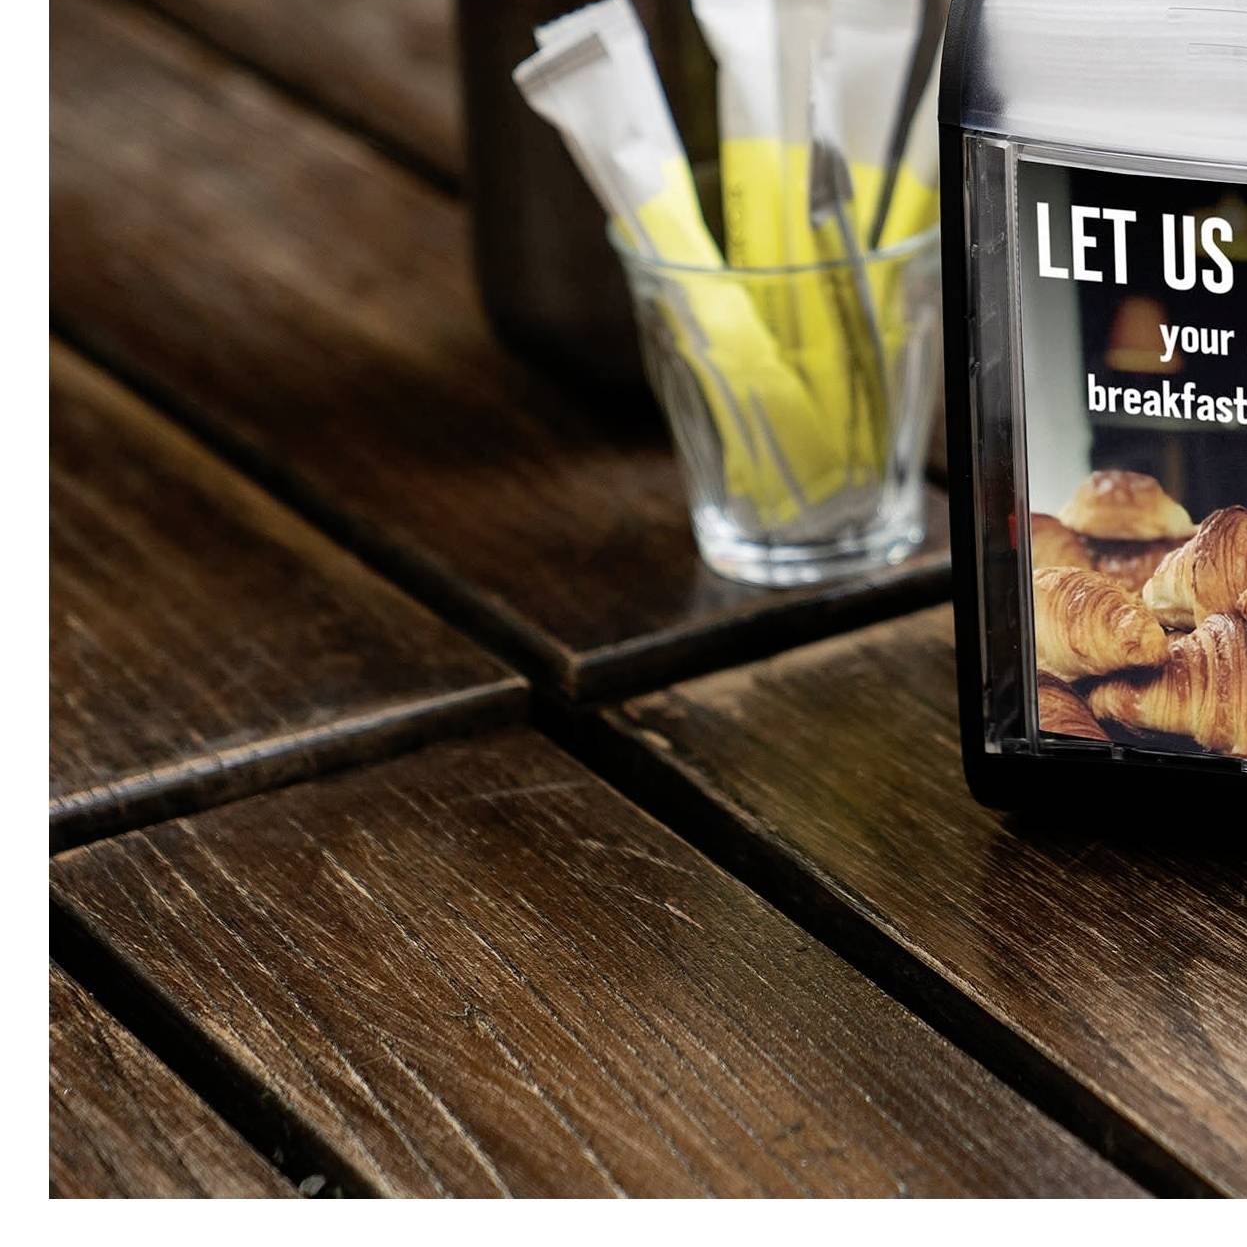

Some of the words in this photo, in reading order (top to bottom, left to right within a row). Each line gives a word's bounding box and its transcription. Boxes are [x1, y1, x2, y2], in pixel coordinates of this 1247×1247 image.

[1036, 201, 1137, 285] LET
[1162, 213, 1234, 294] US
[1159, 323, 1236, 363] your
